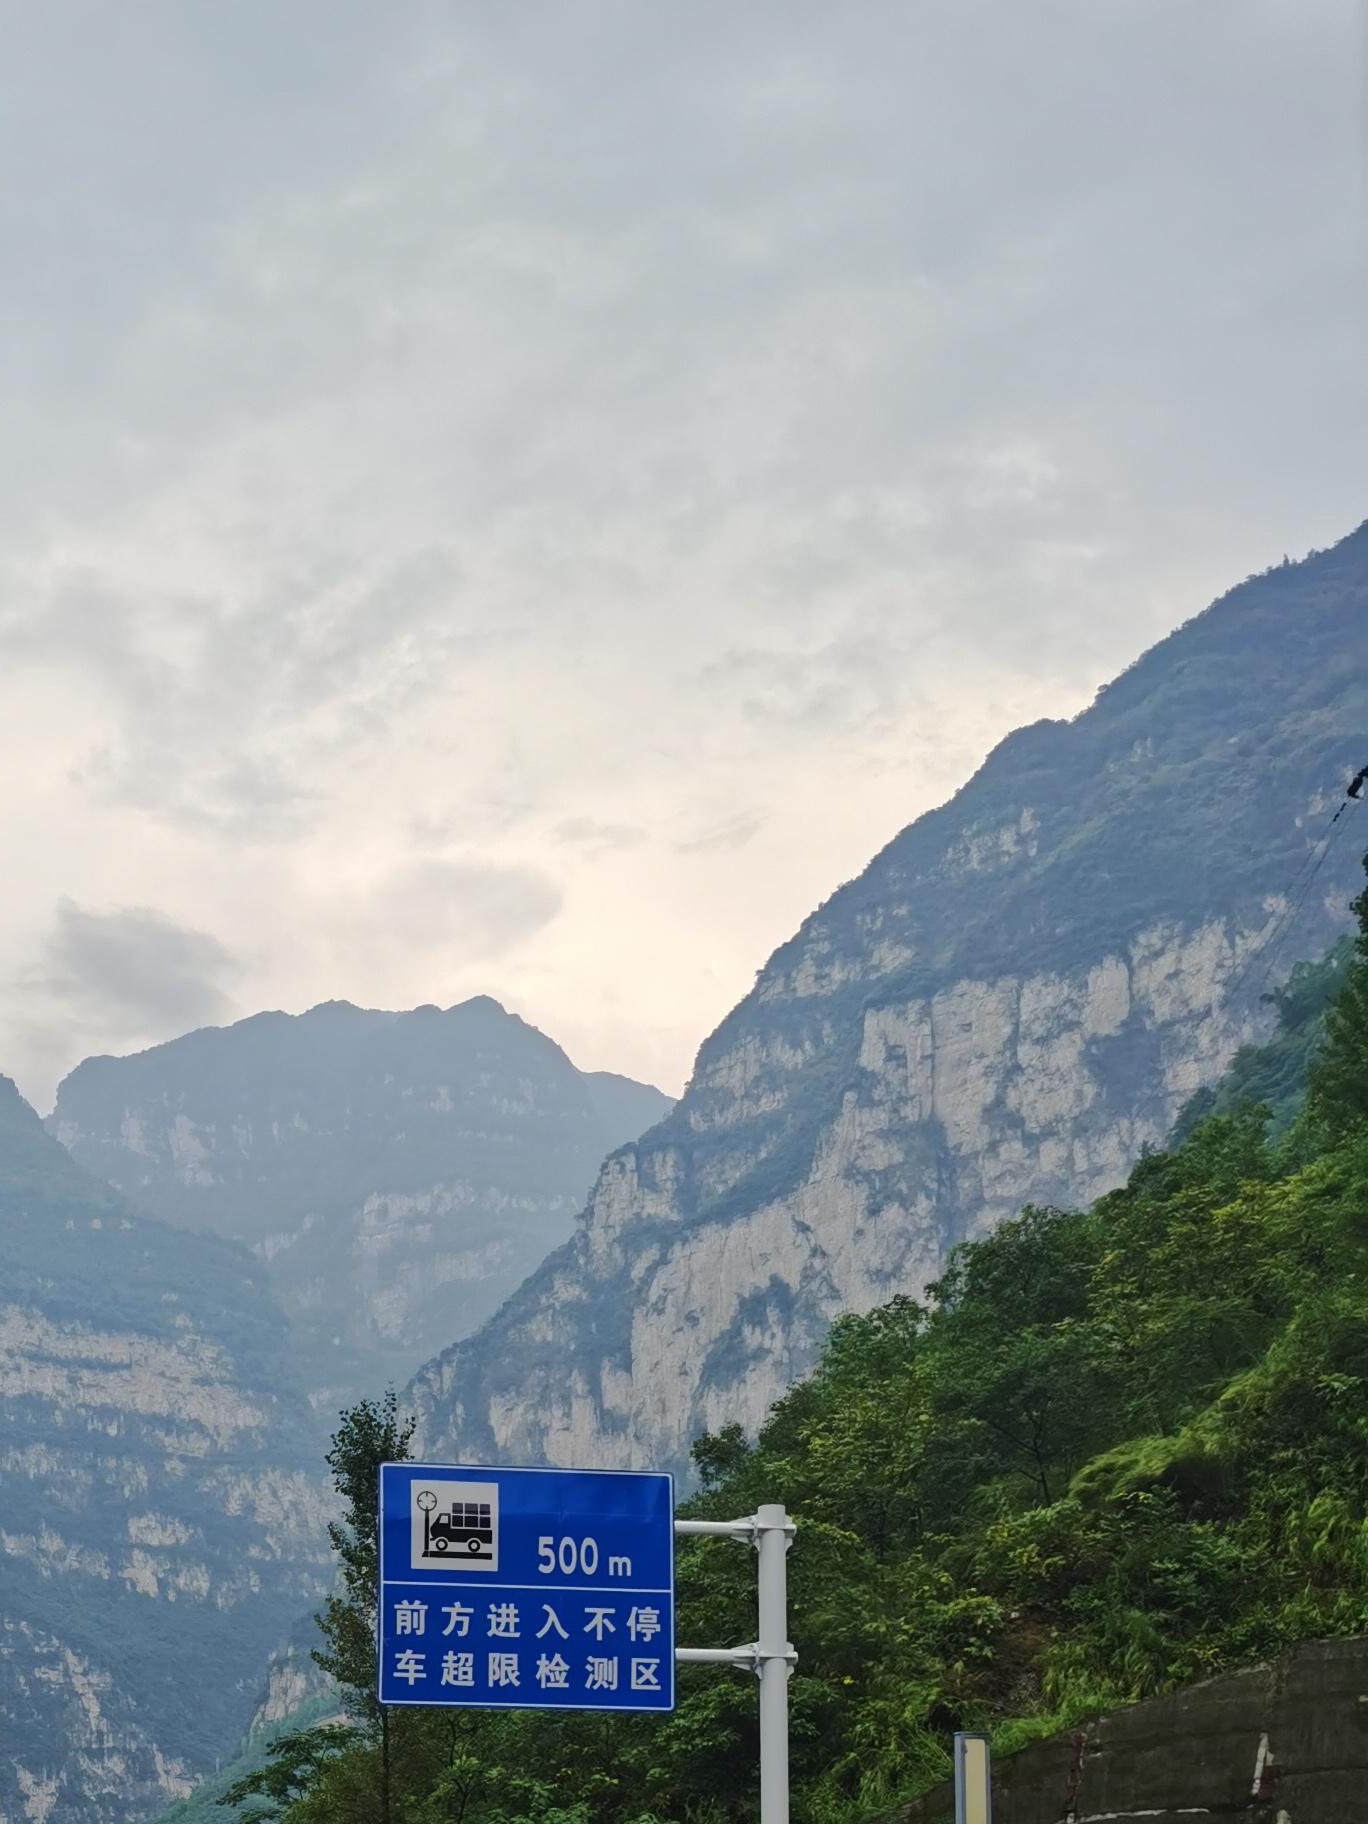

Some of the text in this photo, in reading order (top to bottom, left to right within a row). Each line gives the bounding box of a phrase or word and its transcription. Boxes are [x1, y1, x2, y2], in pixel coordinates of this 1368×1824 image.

[393, 1599, 661, 1642] 前方进入不停
[393, 1649, 661, 1691] 车超限检测区
